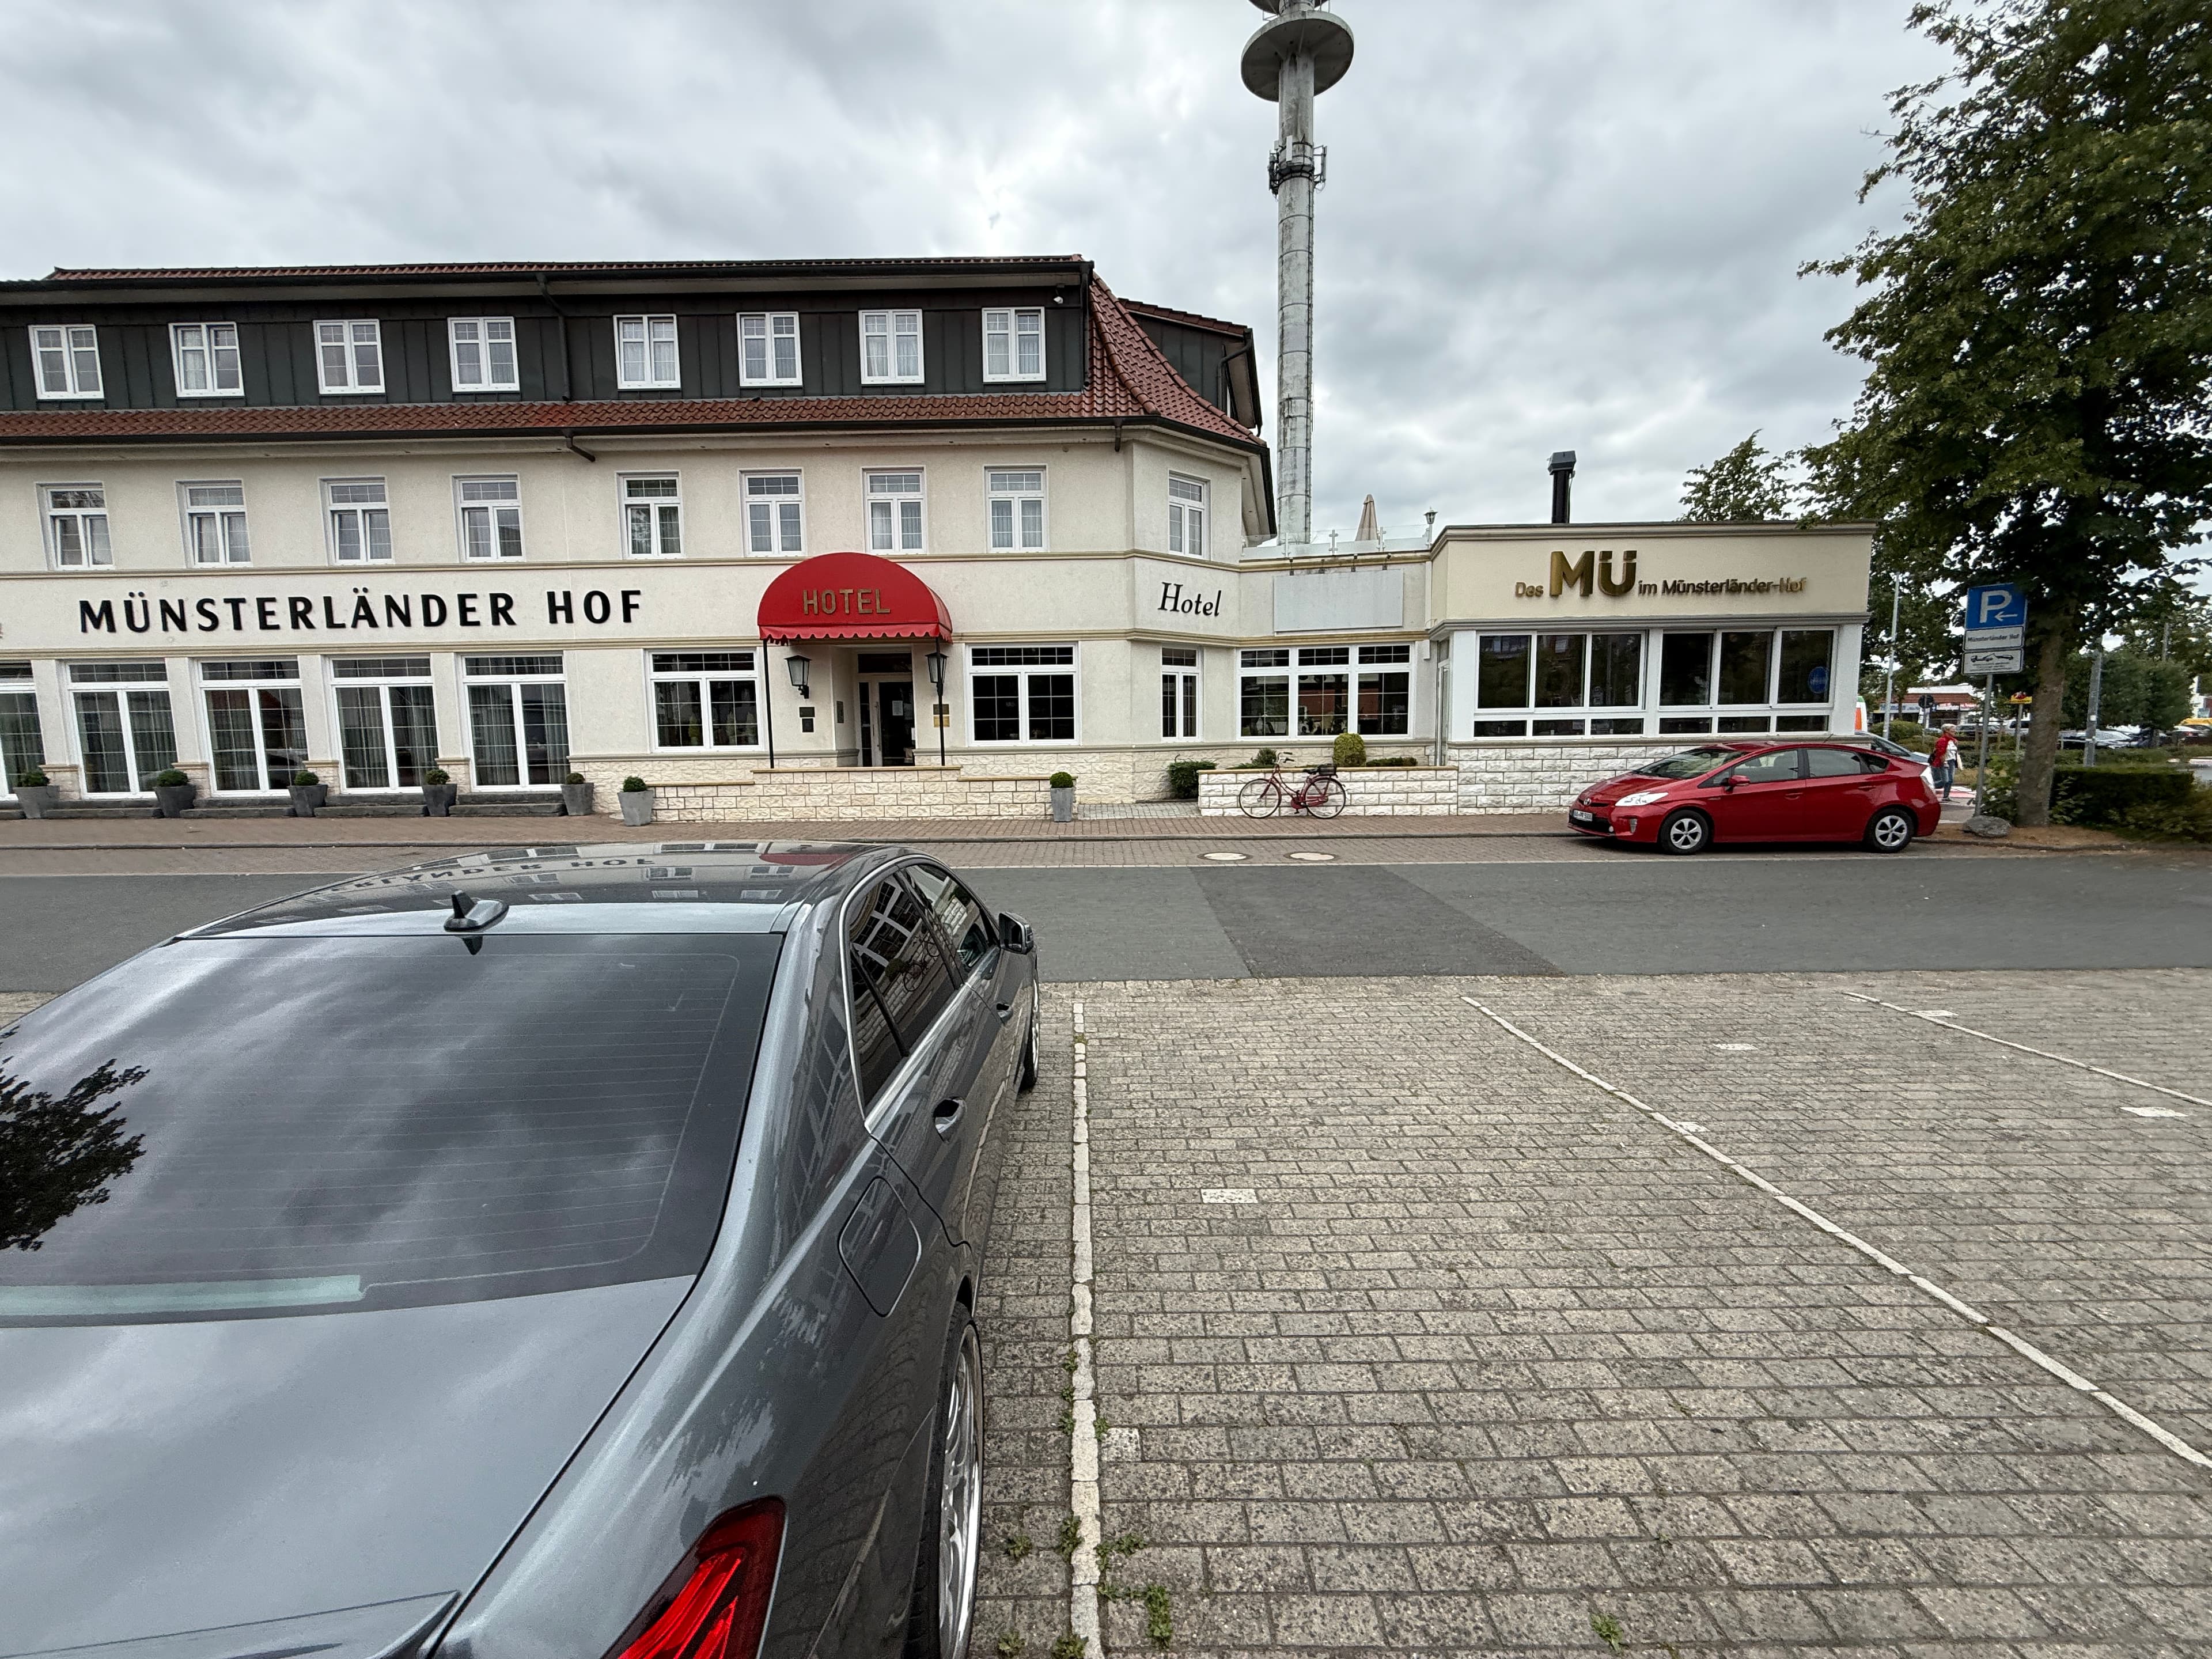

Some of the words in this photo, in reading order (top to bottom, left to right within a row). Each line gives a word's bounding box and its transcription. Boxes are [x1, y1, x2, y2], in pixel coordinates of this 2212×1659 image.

[1515, 582, 1544, 597] Das
[1550, 550, 1637, 597] MÜ
[1638, 580, 1657, 596] im
[1661, 577, 1807, 594] Münsterländer-Hof
[78, 587, 517, 633] MÜNSTERLÄNDER
[547, 589, 641, 624] HOF
[802, 588, 891, 615] HOTEL
[1158, 582, 1222, 617] Hotel
[1980, 590, 2012, 623] P
